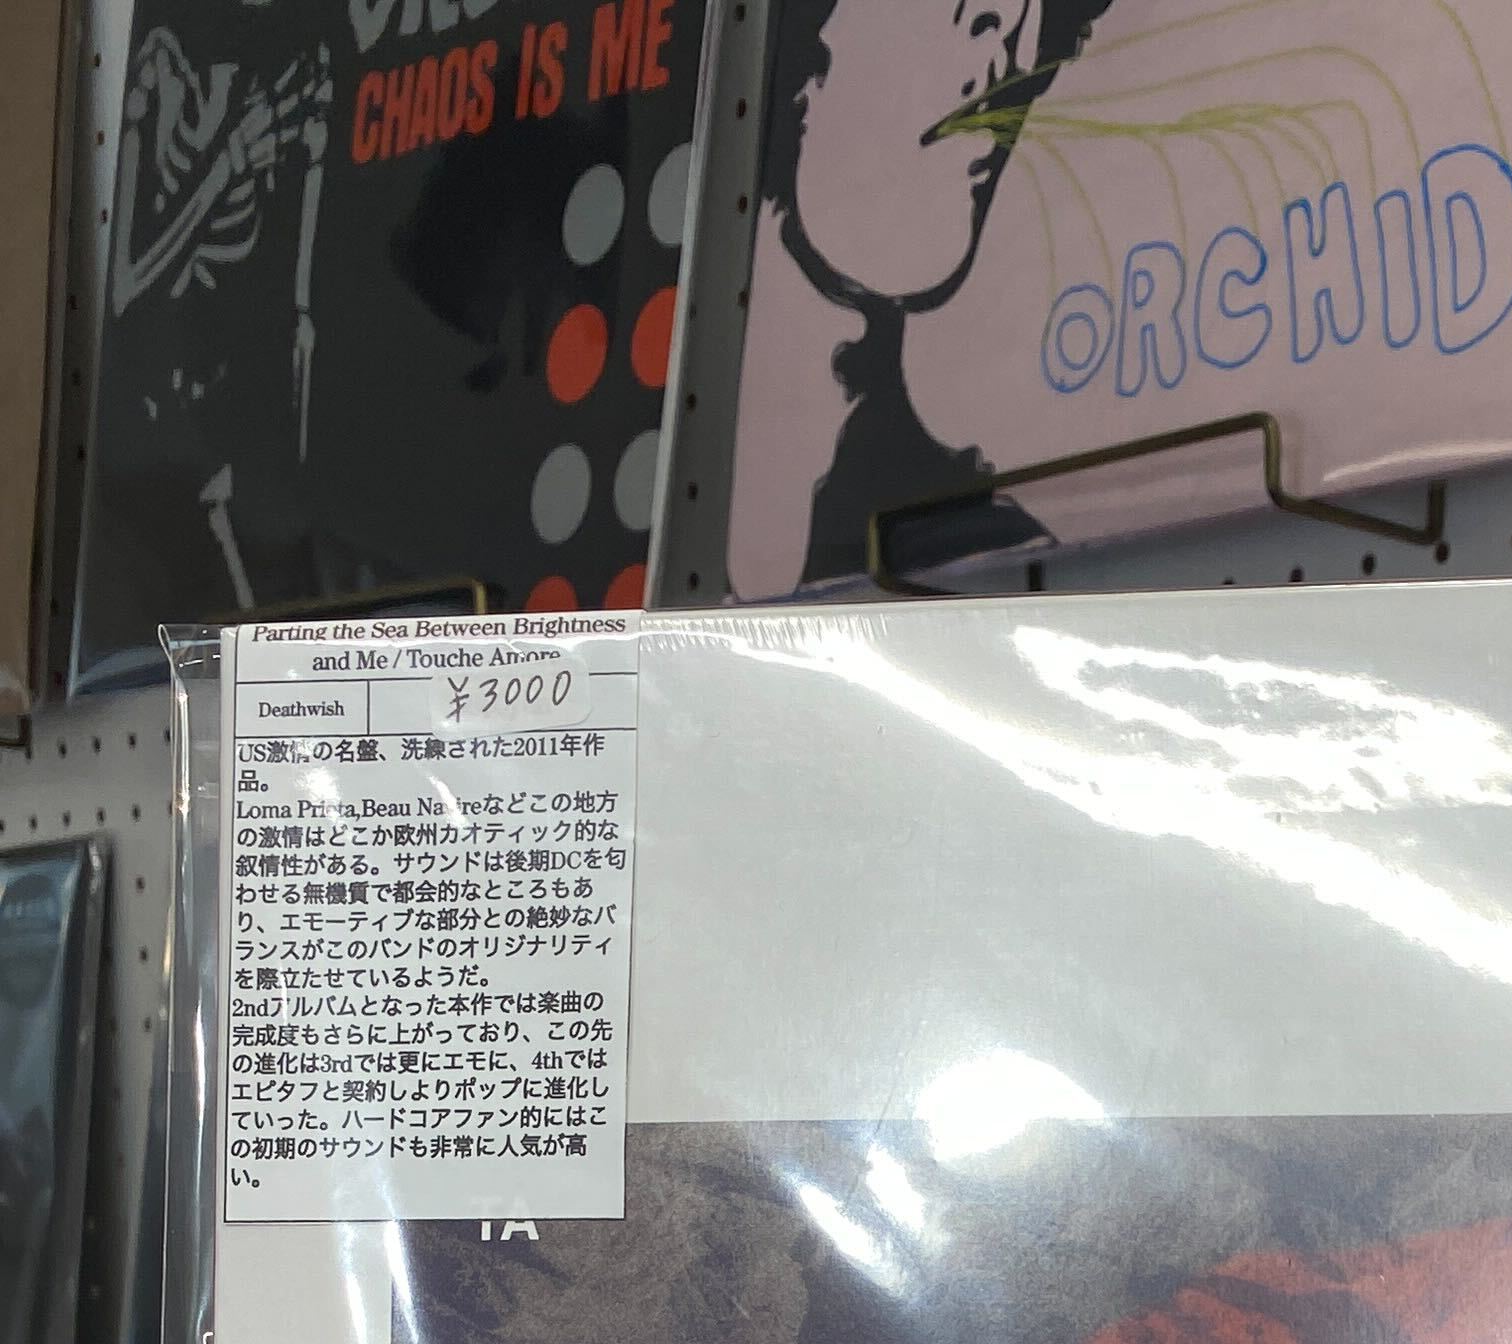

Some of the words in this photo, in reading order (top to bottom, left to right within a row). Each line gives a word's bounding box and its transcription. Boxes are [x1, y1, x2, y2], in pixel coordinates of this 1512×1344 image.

[352, 39, 498, 165] CHAOS
[514, 21, 568, 120] IS
[588, 0, 676, 102] ME
[252, 625, 328, 642] Parting
[333, 625, 366, 639] the
[371, 621, 408, 638] Sea
[415, 620, 506, 637] Between
[513, 617, 626, 638] Brightness
[313, 651, 350, 671] and
[356, 650, 388, 670] Me
[407, 648, 483, 668] Touche
[258, 701, 345, 718] Deathwish
[238, 770, 269, 792] 品。
[237, 801, 291, 819] Loma
[417, 790, 618, 816] Naireなどこの地方
[236, 877, 593, 905] わせる無機質で都会的なところもあ
[238, 904, 617, 932] り、エモーティブな部分との絶妙なバ
[235, 934, 612, 960] ランスがこのバンドのオリジナリティ
[234, 964, 489, 990] を際立たせているようだ。
[232, 1019, 613, 1047] 完成度もさらに上がっており、この先
[231, 1076, 609, 1102] エピタフと契約しよりポップに進化し
[231, 1105, 607, 1130] ていった。ハードコアファン的にはこ
[230, 1133, 587, 1160] の初期のサウンドも非常に人気が高
[231, 1167, 260, 1187] い。
